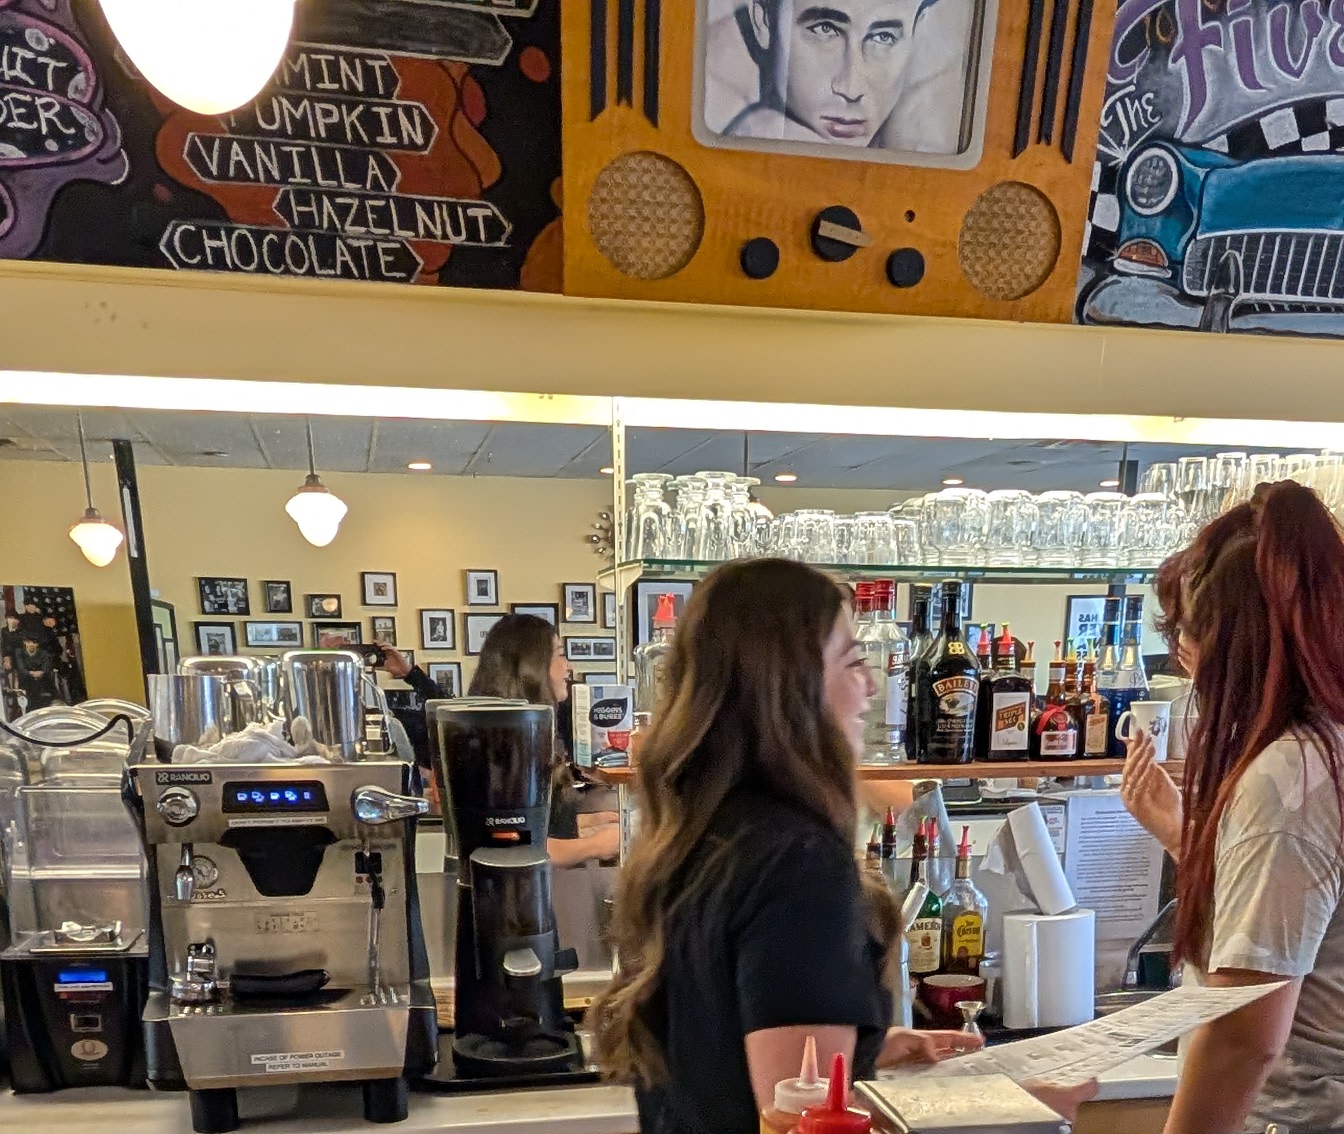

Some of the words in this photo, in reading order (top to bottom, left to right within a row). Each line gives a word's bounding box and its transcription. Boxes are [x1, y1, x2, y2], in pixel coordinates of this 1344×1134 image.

[276, 52, 389, 96] MINT
[232, 96, 428, 147] UMPKIN
[1102, 82, 1161, 148] The
[195, 136, 394, 193] VANILLA
[290, 190, 493, 243] HAZELNUT
[173, 224, 408, 278] CHOCOLATE
